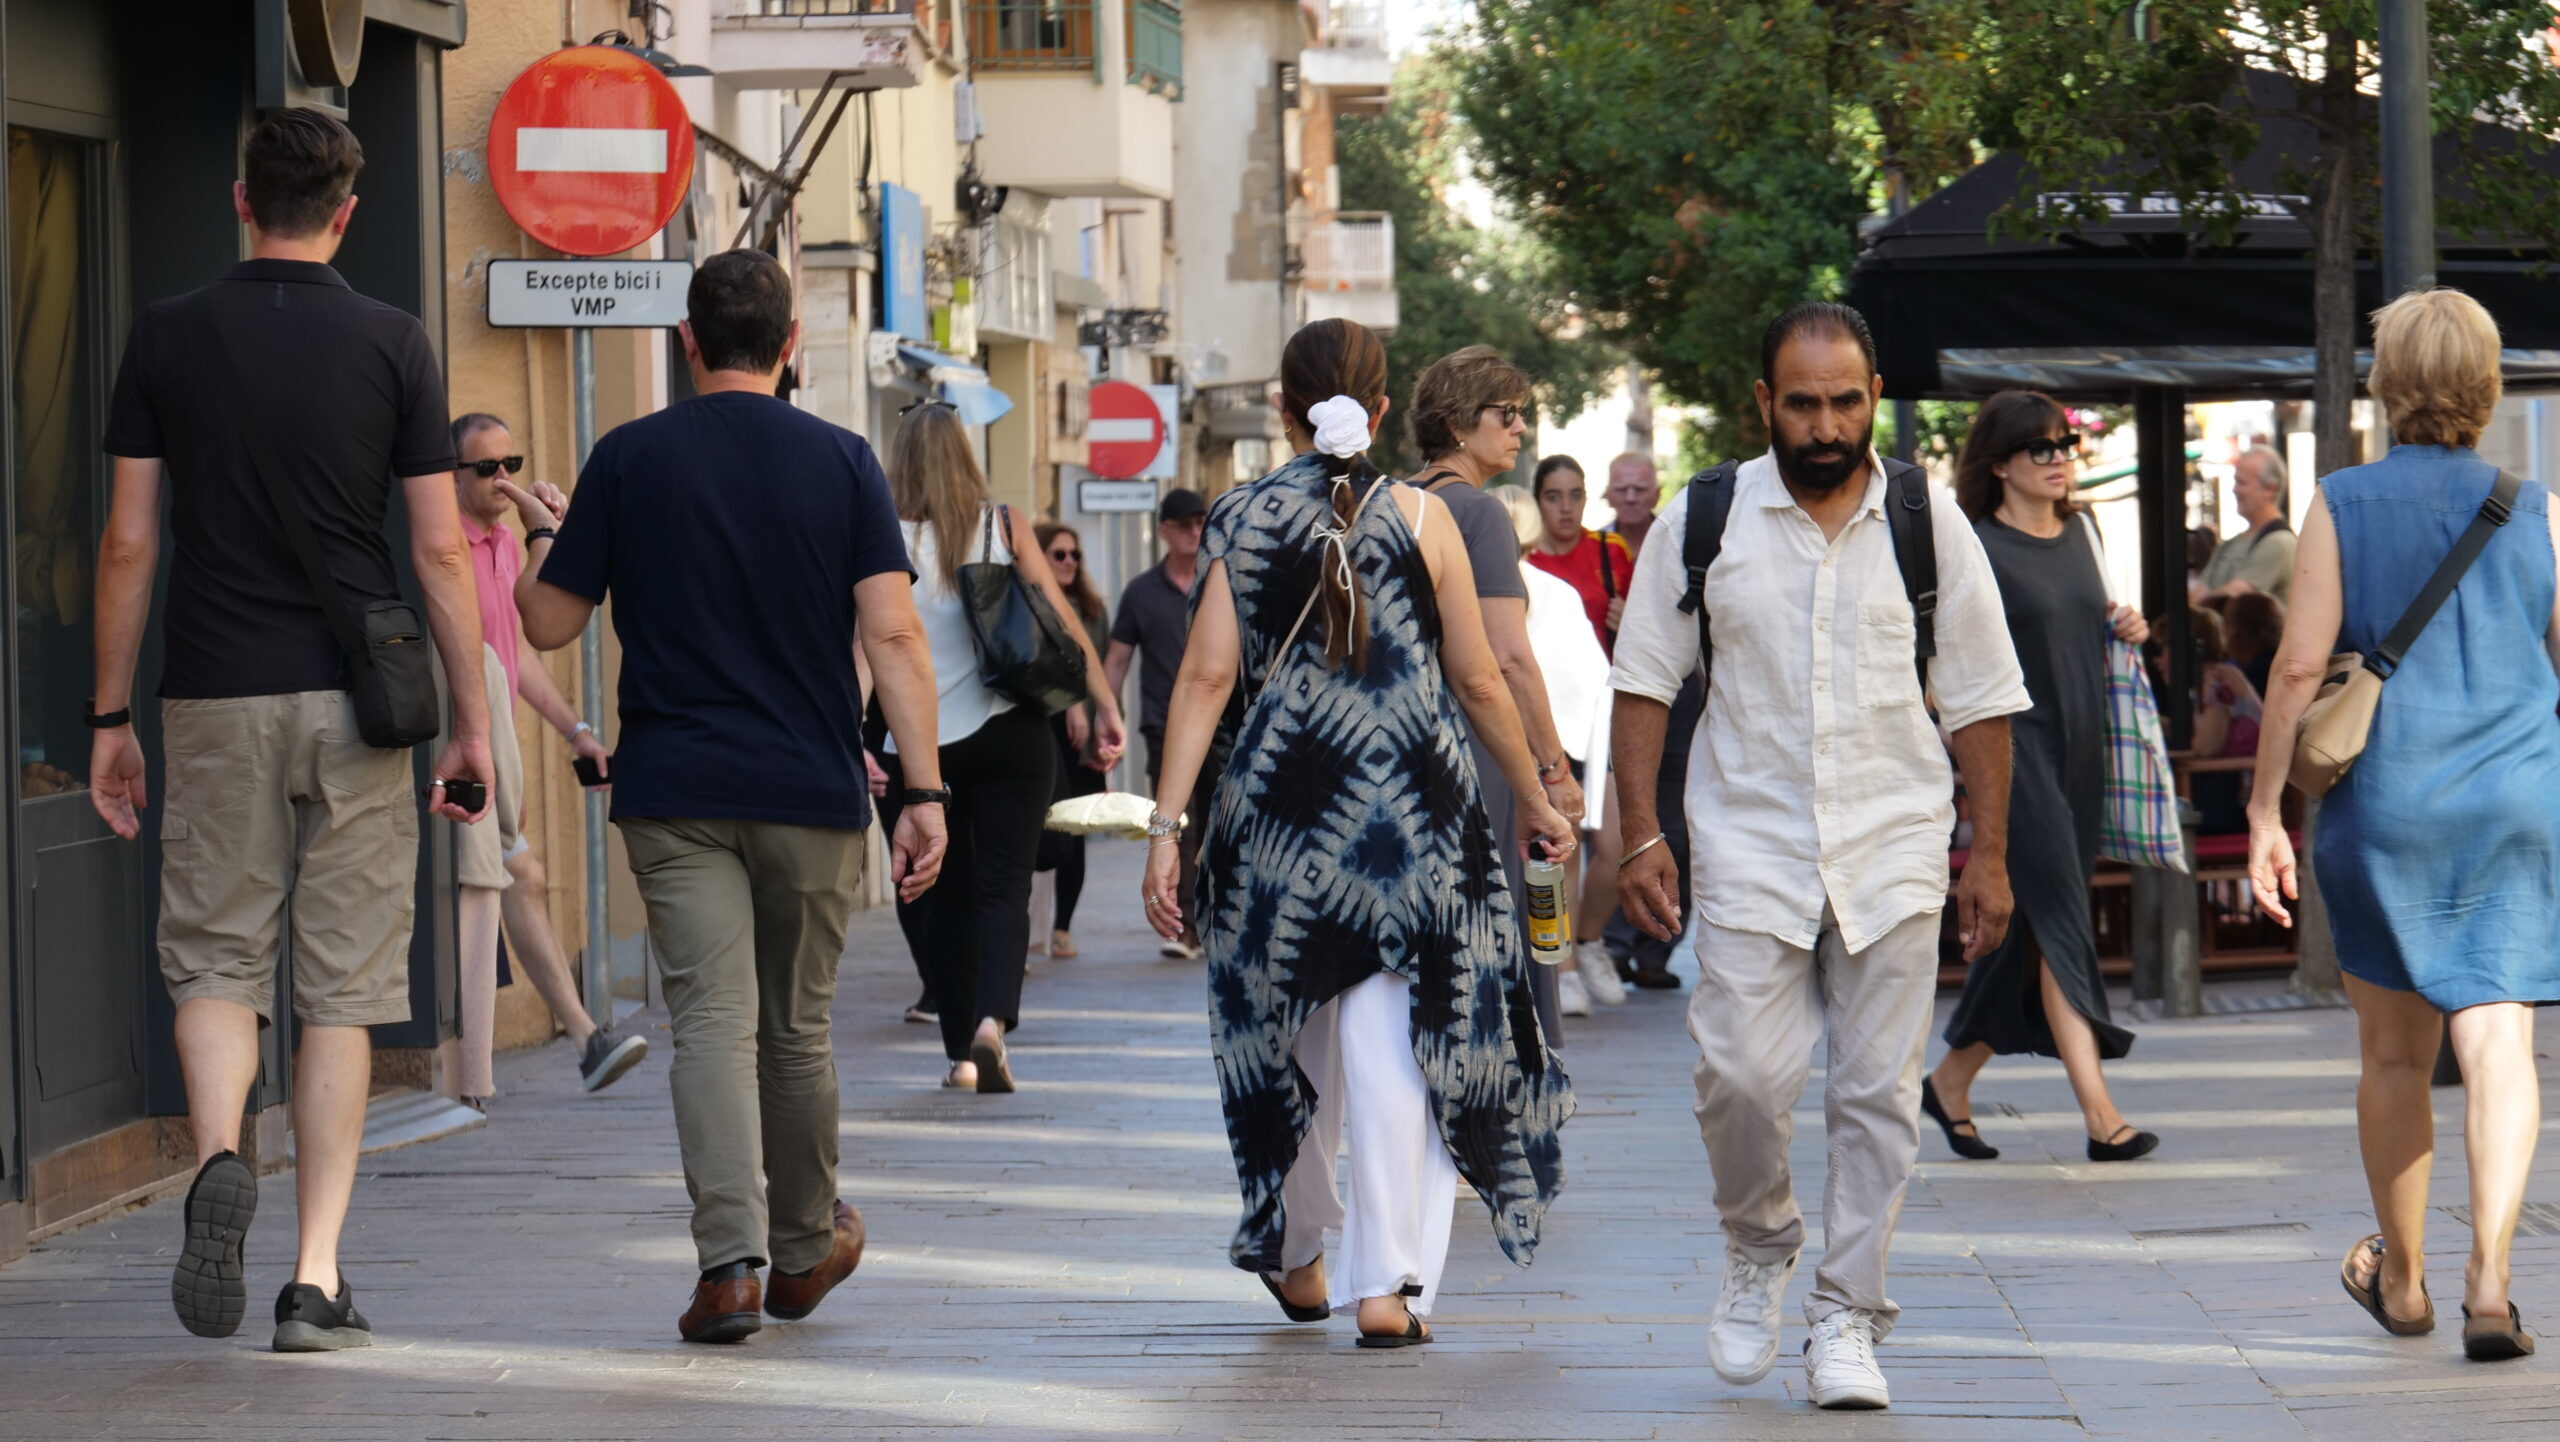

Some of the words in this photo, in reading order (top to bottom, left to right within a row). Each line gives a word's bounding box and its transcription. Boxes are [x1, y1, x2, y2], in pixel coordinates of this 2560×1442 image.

[526, 270, 608, 293] Excepte
[614, 270, 650, 290] bici
[655, 270, 661, 290] i
[570, 297, 616, 316] VMP
